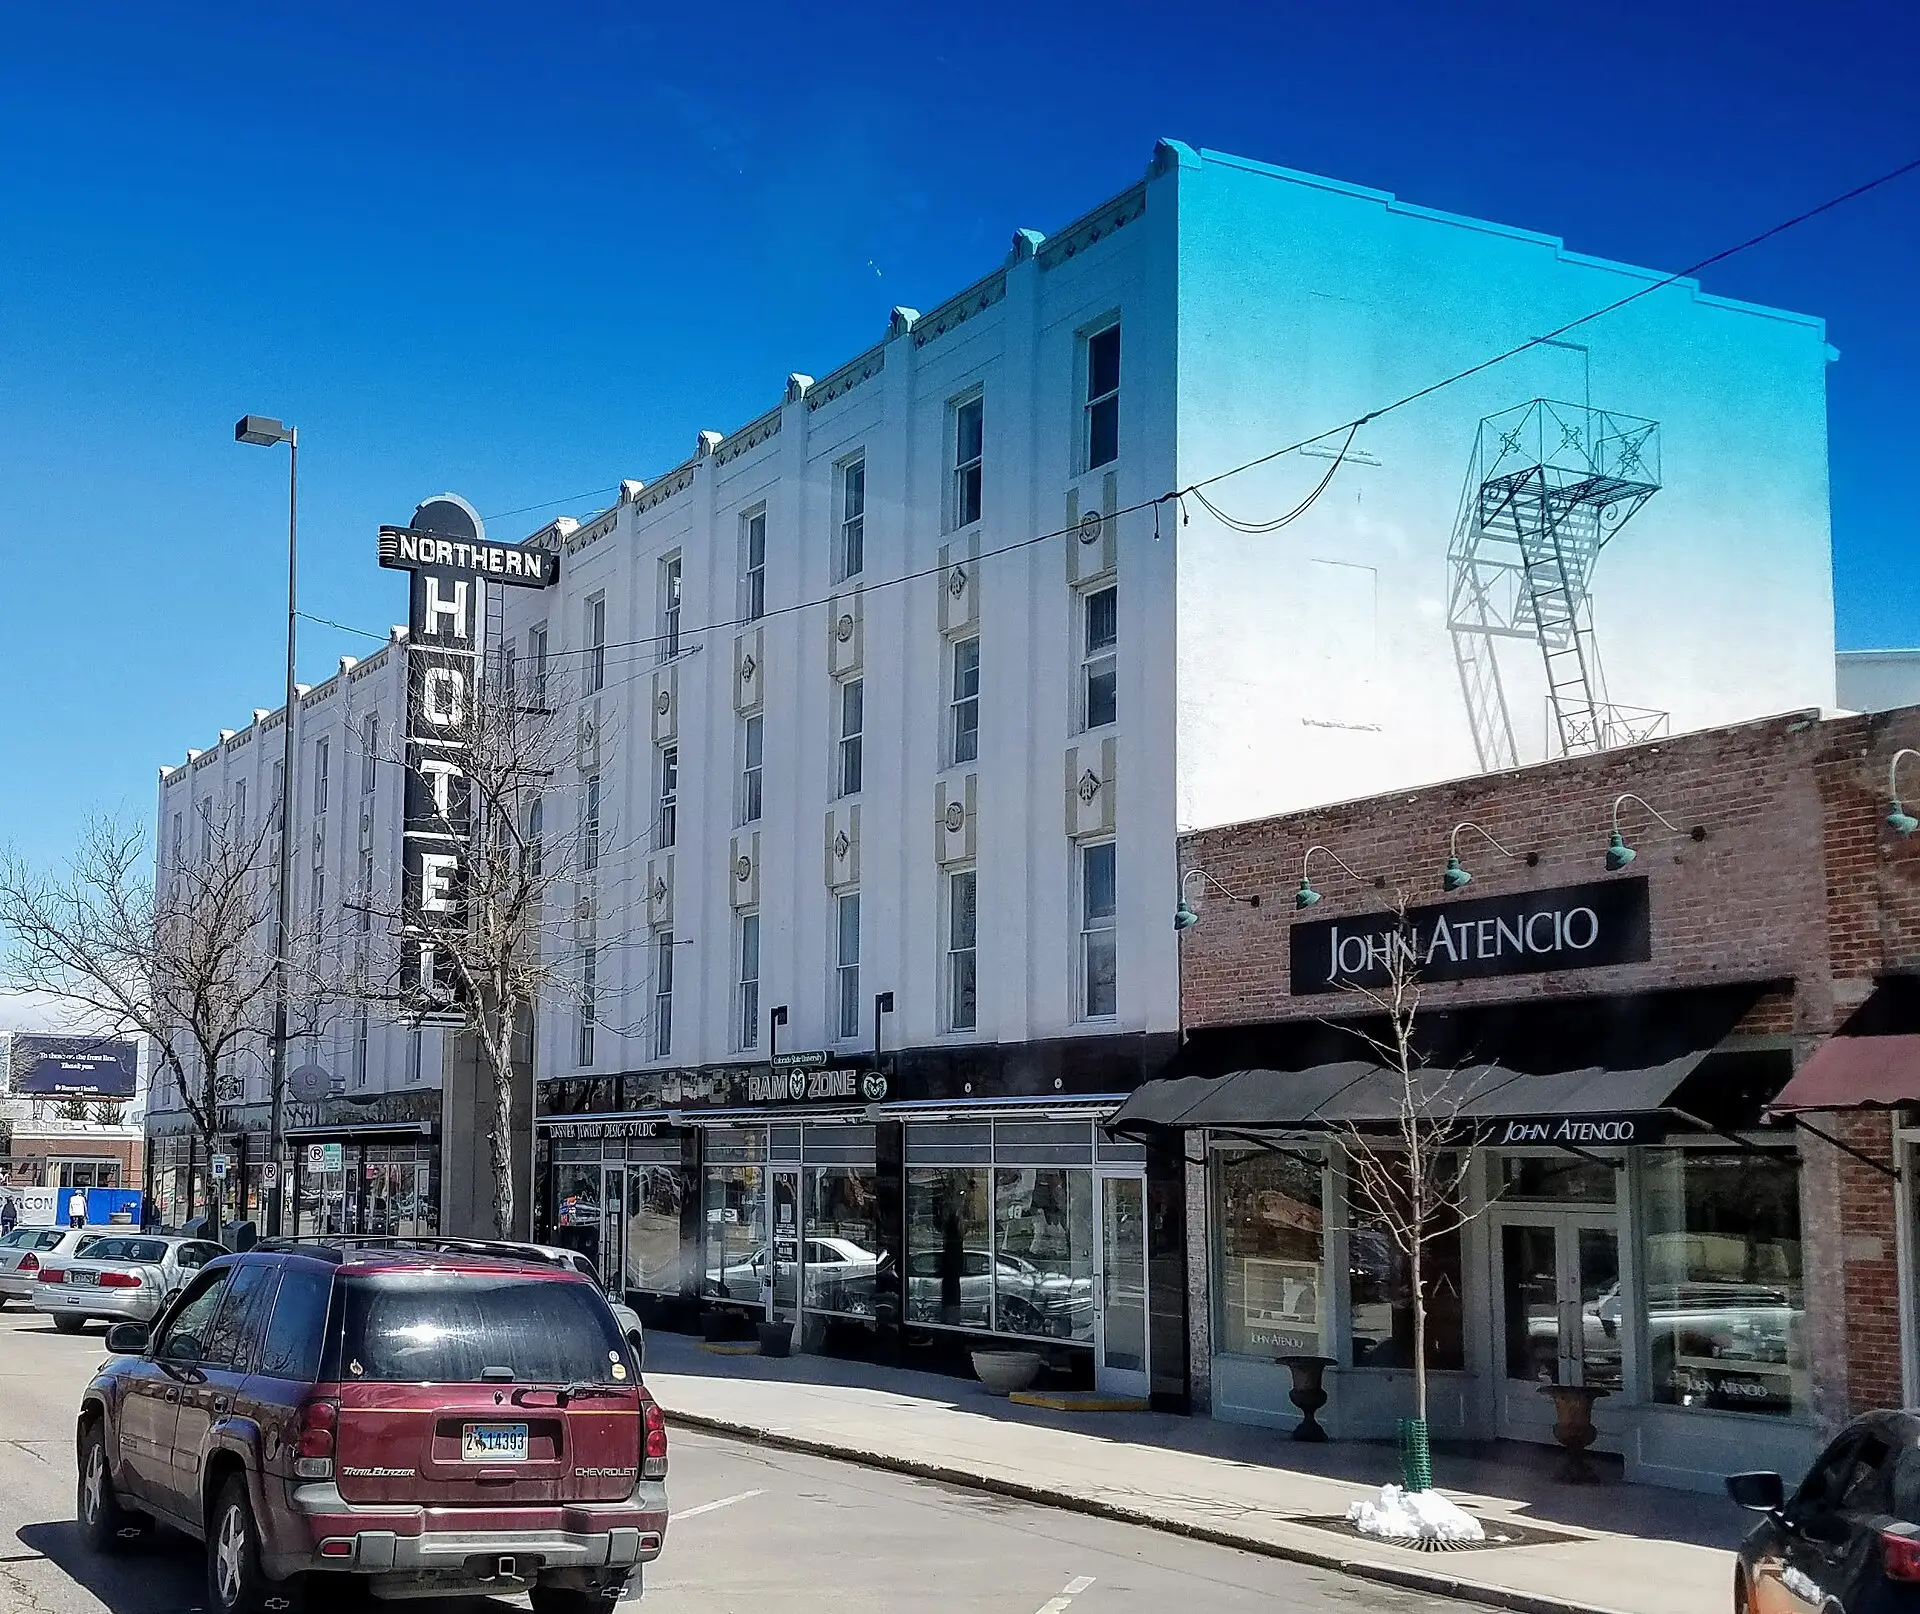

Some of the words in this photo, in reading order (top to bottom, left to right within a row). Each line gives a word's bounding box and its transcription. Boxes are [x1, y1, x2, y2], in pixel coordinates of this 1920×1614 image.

[399, 534, 542, 579] NORTHERN
[418, 576, 469, 1001] HOTEL
[1327, 926, 1417, 981] JOHN
[1425, 907, 1599, 965] ATENCIO
[748, 1075, 788, 1101] RAM
[807, 1069, 857, 1098] ZONE
[1500, 1121, 1550, 1144] JOHN
[487, 1432, 525, 1451] 14393
[575, 1467, 637, 1477] CHEVROLET
